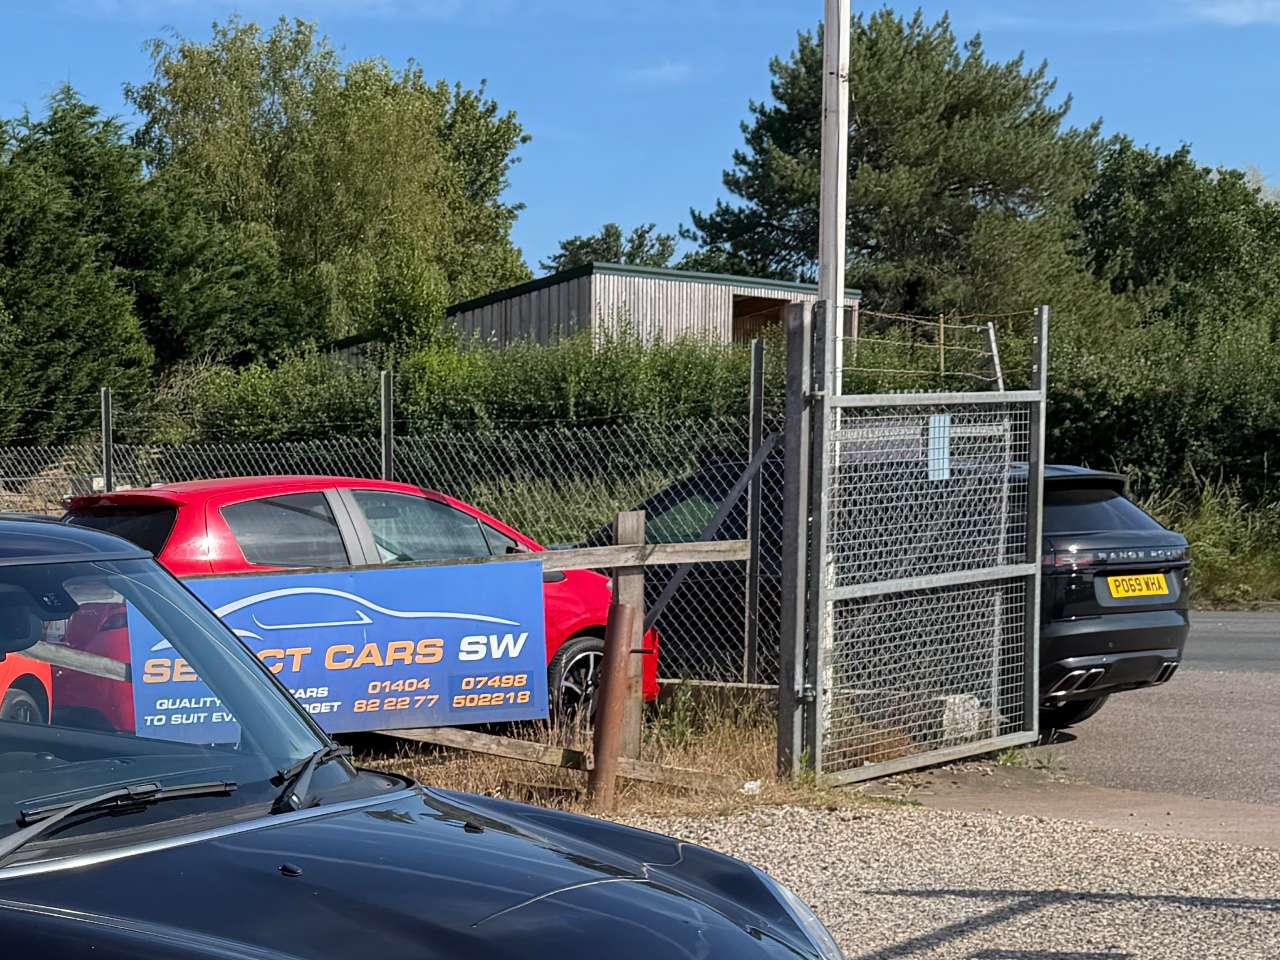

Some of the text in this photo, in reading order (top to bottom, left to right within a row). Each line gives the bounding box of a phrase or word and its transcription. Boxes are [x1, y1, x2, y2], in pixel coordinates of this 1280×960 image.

[325, 638, 445, 670] CARS
[458, 632, 529, 661] SW
[368, 678, 431, 694] 01404
[461, 674, 528, 690] 07498
[156, 697, 222, 710] QUALITY
[354, 694, 440, 713] 82 22 77
[452, 690, 531, 708] 502218
[144, 715, 166, 726] TO
[171, 712, 208, 725] SUIT
